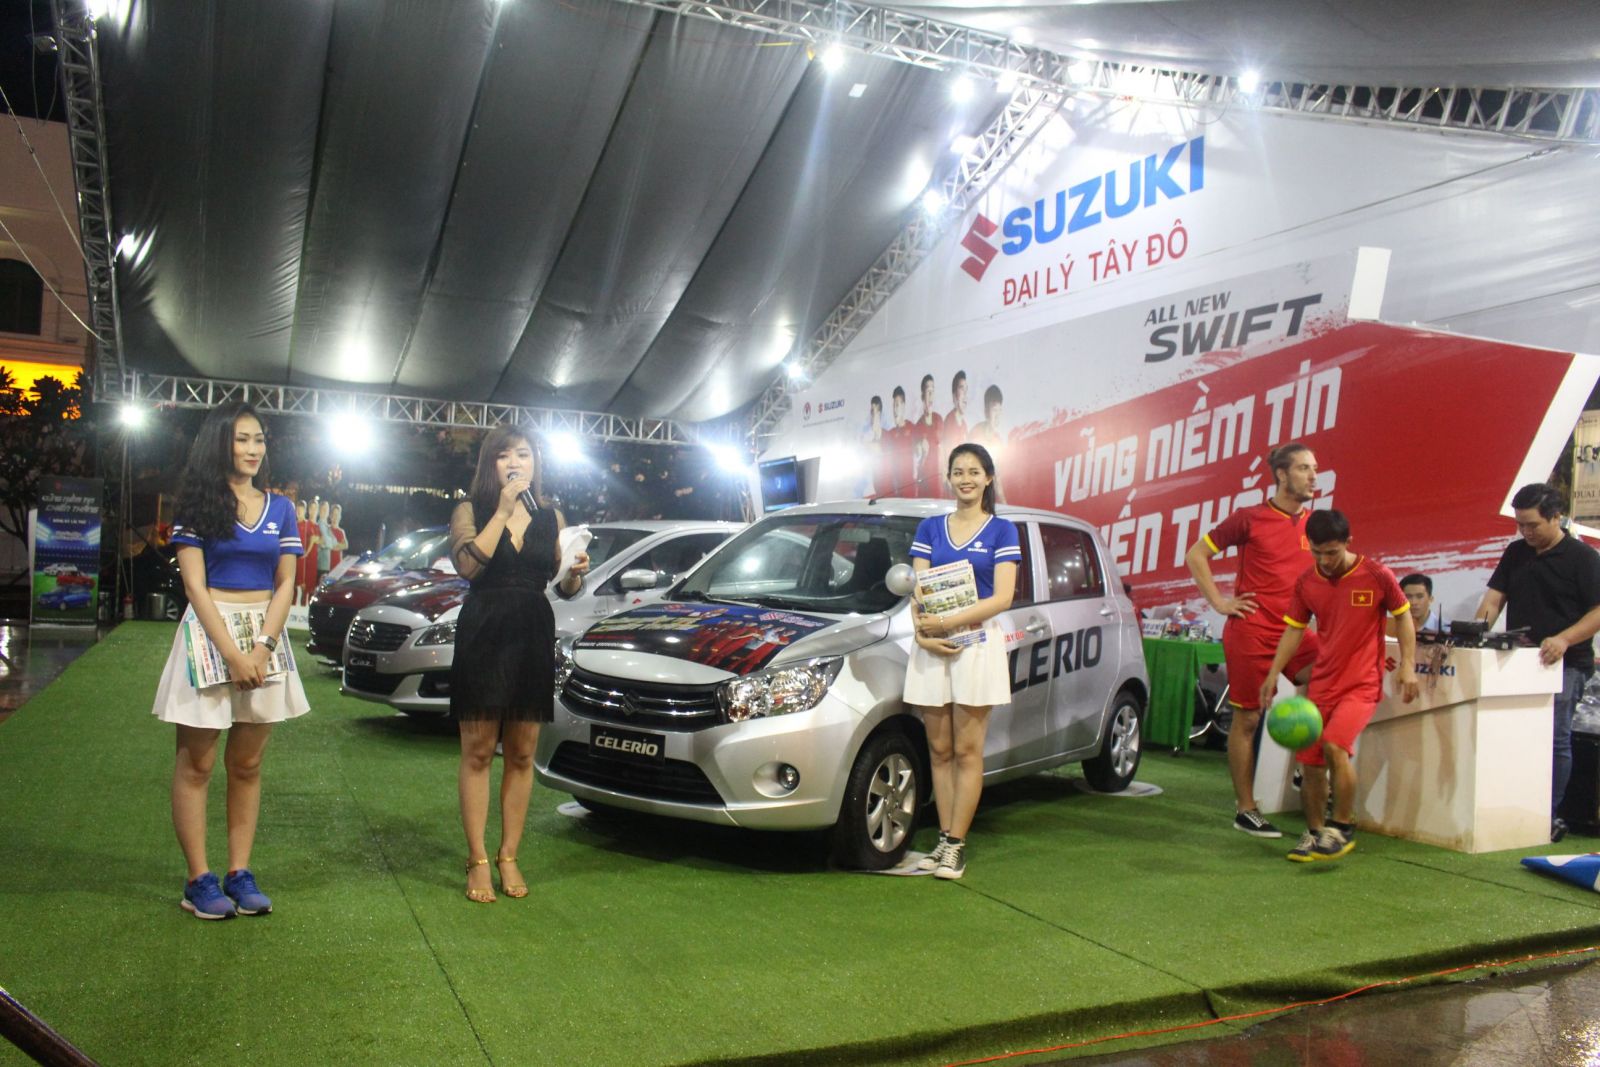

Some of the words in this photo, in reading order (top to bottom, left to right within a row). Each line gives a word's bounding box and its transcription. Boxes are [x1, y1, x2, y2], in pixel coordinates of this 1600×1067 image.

[1001, 135, 1204, 256] SUZUKI
[1003, 270, 1038, 307] ĐẠI
[1046, 254, 1074, 295] LÝ
[1089, 239, 1139, 281] TÂY
[1146, 218, 1188, 266] ĐÔ
[1144, 304, 1178, 326] ALL
[1184, 291, 1231, 318] NEW
[1144, 293, 1323, 362] SWIFT
[824, 399, 845, 411] SUZUKI
[1145, 380, 1255, 482] NIỀM
[1007, 626, 1102, 694] LERIO
[595, 735, 658, 757] CELERIO
